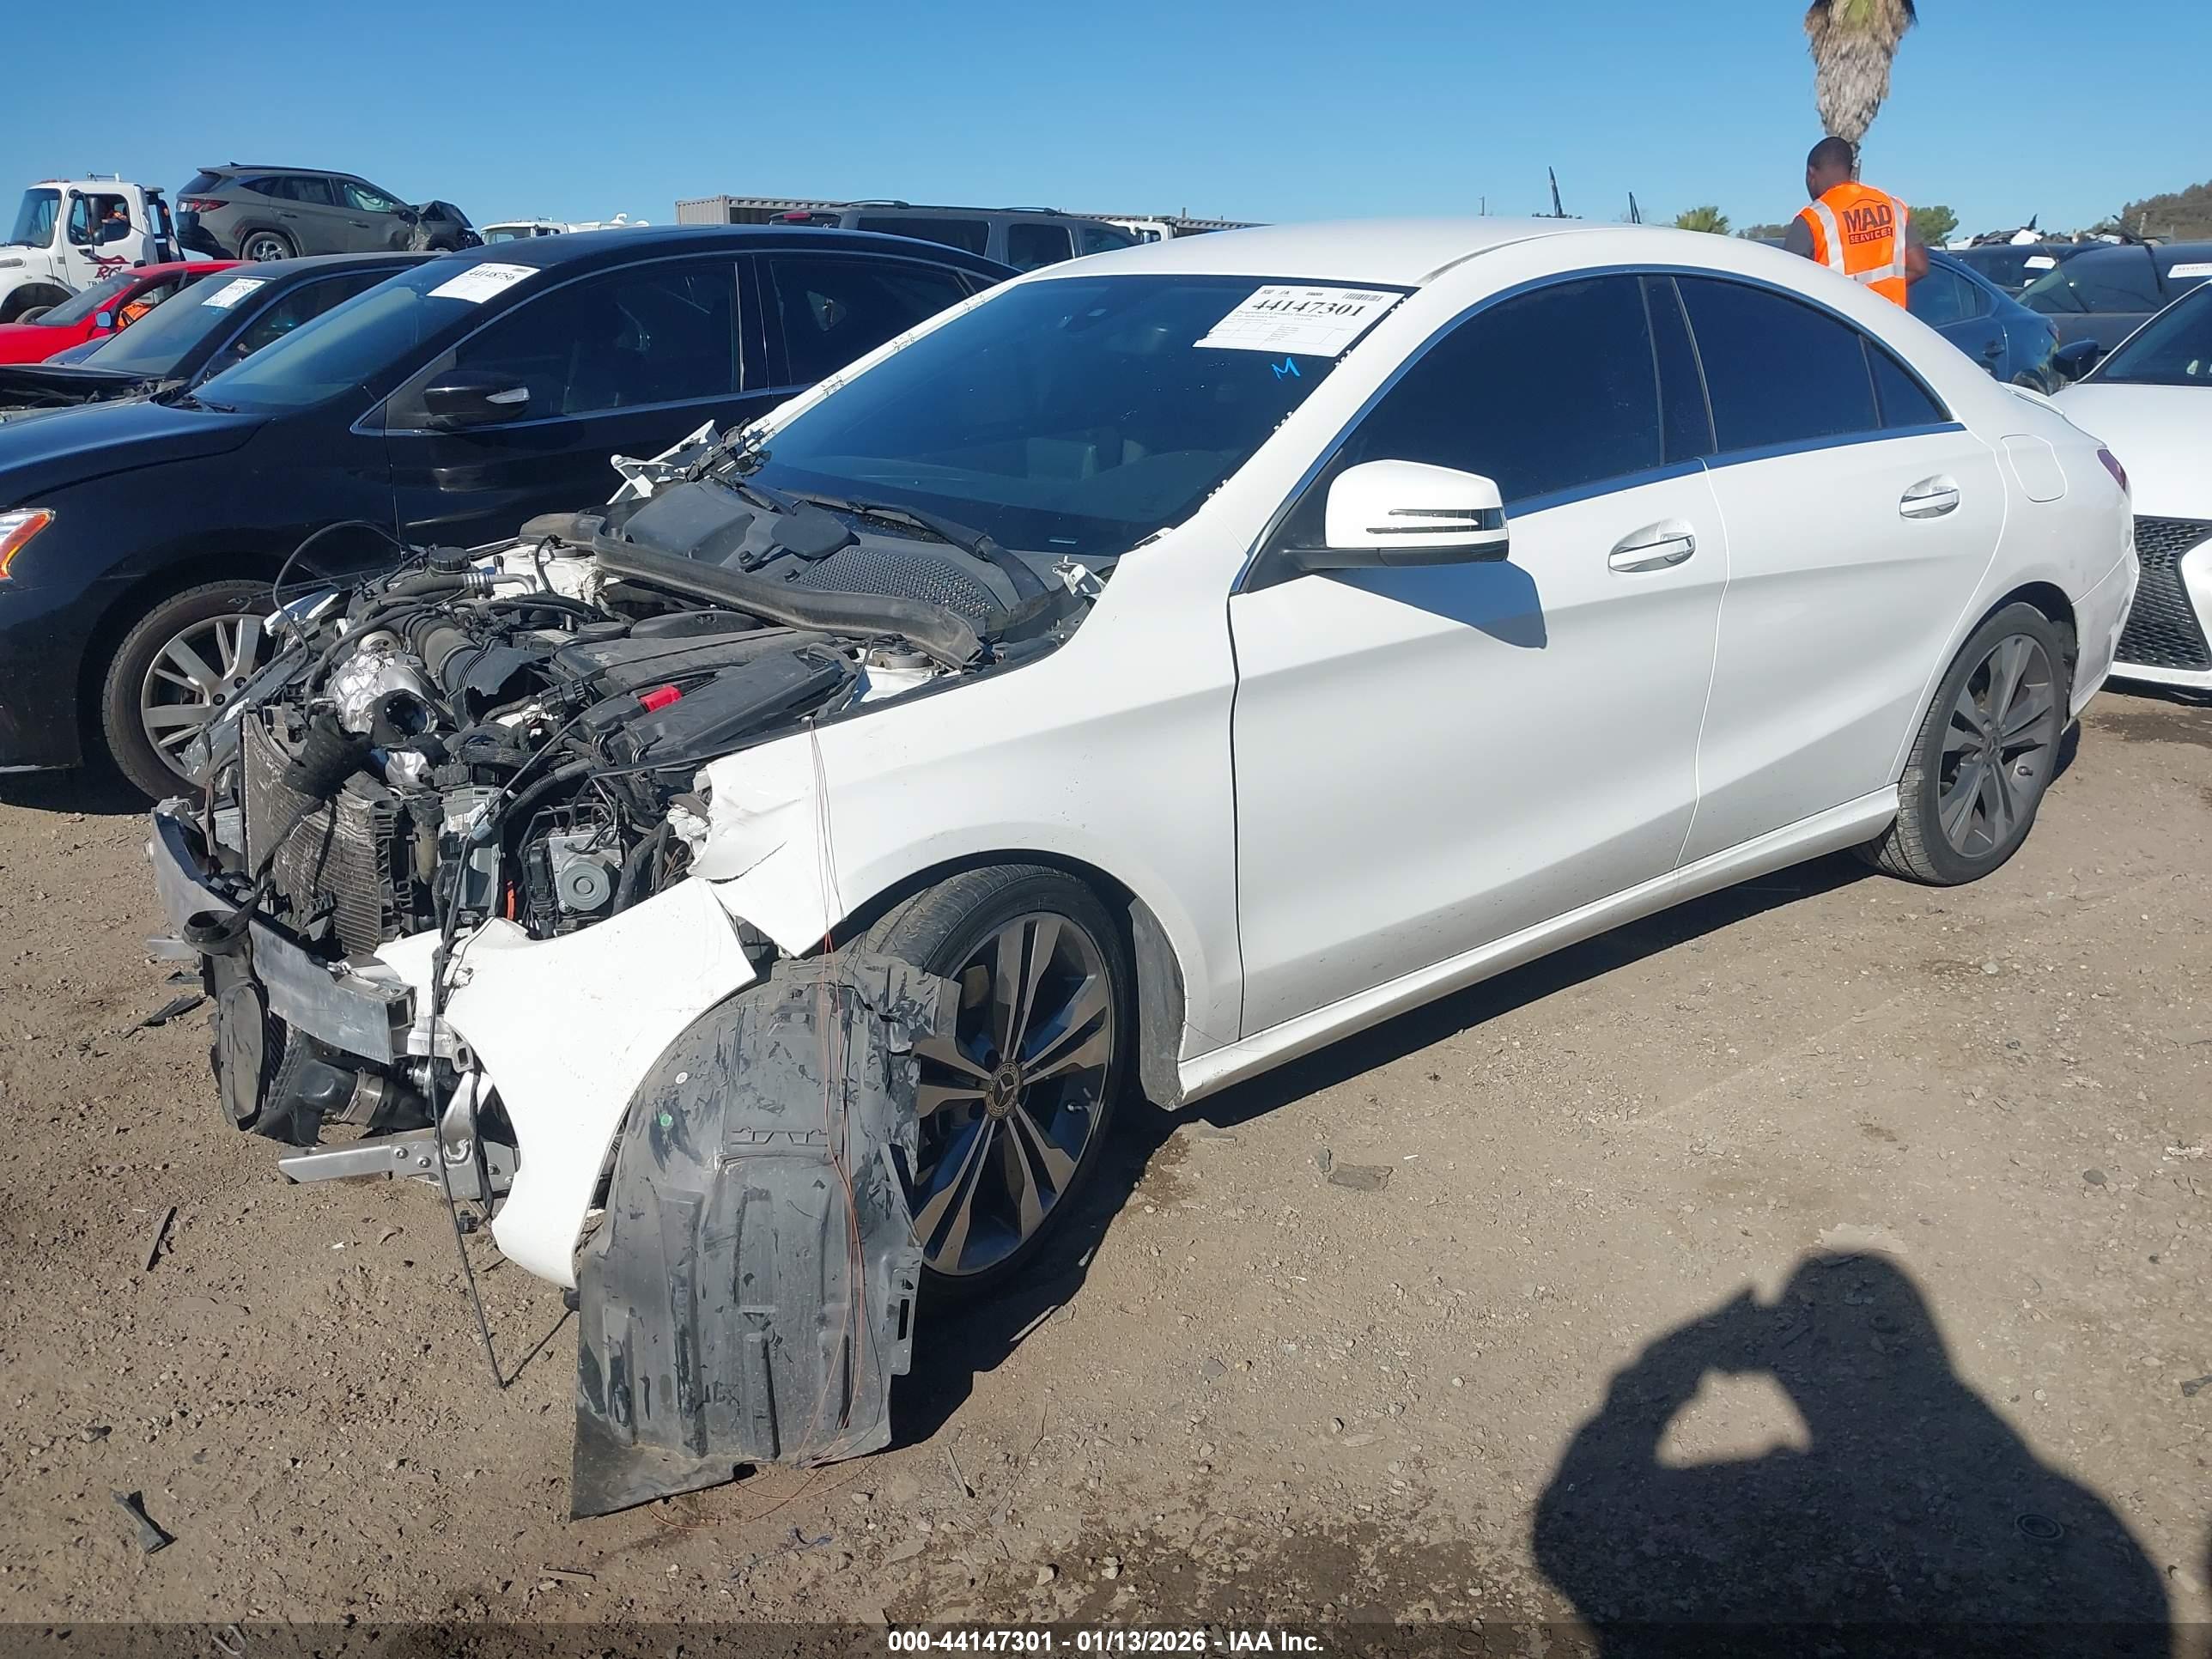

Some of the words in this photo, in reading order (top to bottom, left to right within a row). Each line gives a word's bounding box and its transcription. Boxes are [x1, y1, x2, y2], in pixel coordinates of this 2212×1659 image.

[1842, 204, 1893, 234] MAD
[1252, 299, 1366, 317] 44147301
[1271, 357, 1301, 380] M
